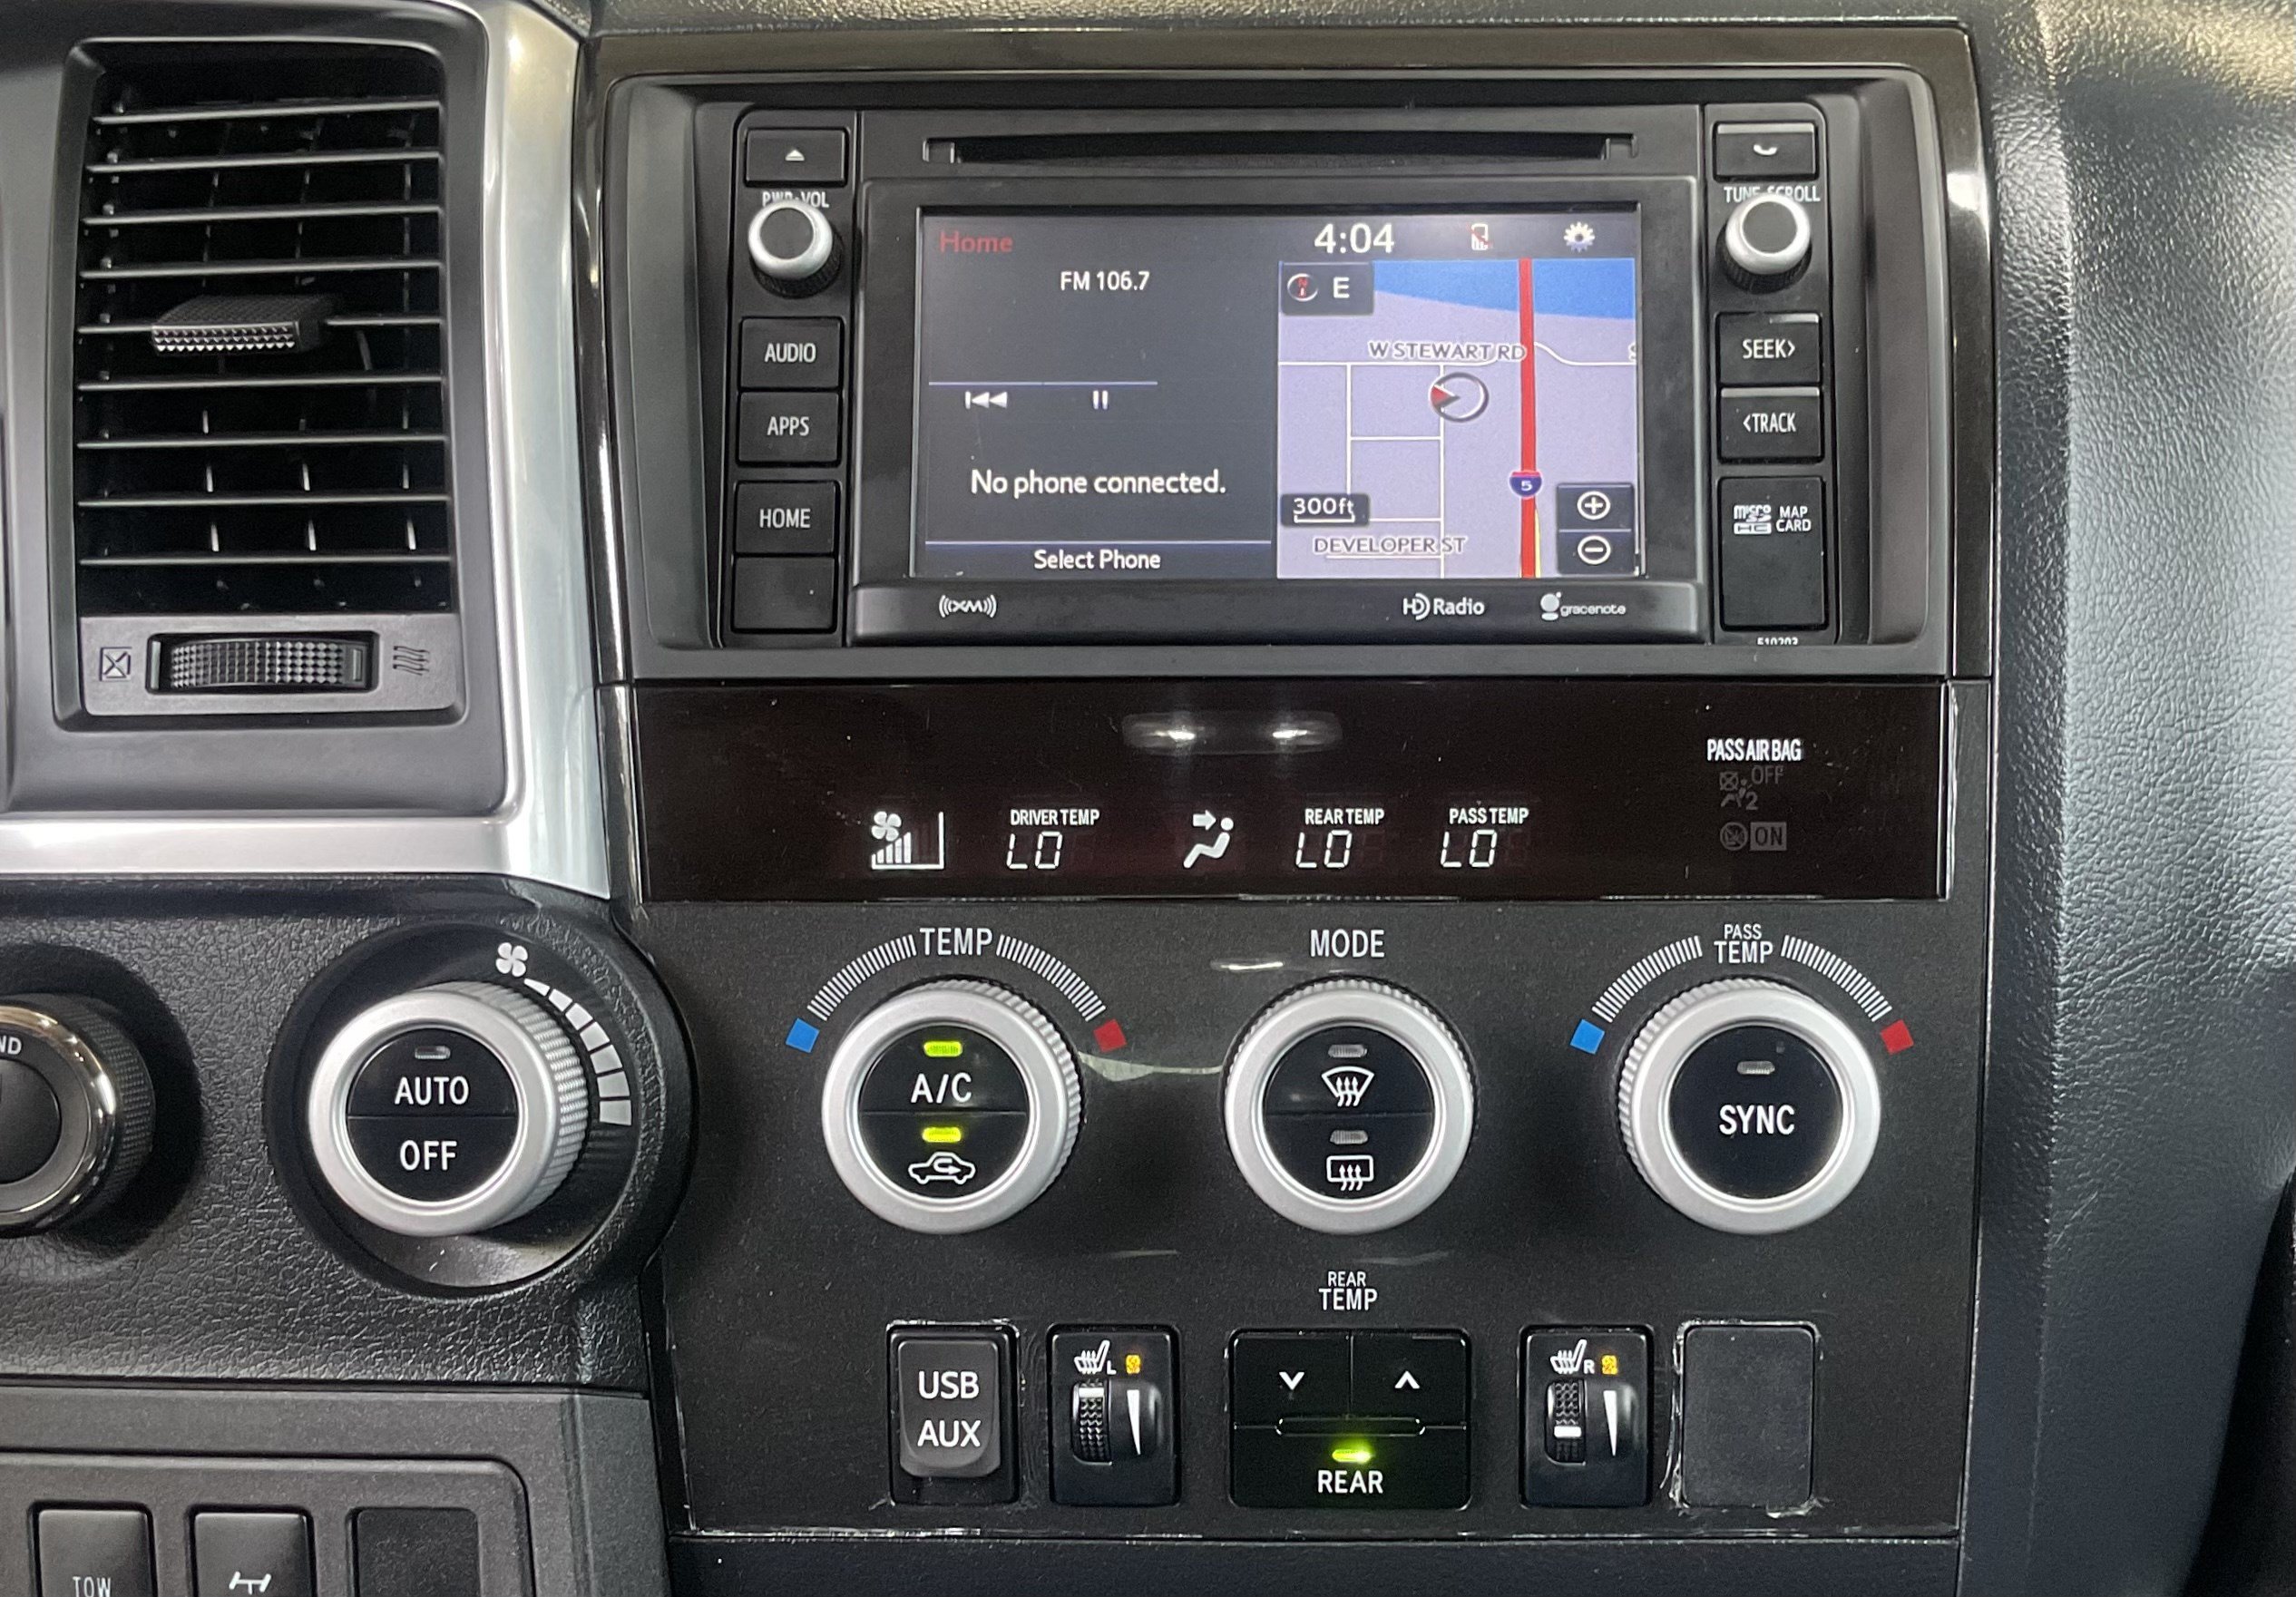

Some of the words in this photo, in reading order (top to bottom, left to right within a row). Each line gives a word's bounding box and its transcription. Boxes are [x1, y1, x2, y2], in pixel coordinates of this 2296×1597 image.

[940, 232, 1011, 251] Home
[1314, 223, 1394, 253] 4:04
[1061, 271, 1089, 290] FM
[1097, 271, 1149, 290] 106.7
[1334, 277, 1349, 297] E
[765, 343, 816, 362] AUDIO
[1368, 339, 1388, 359] W
[1393, 341, 1491, 360] STEWART
[1498, 345, 1526, 360] RD
[767, 417, 809, 435] APPS
[972, 469, 1007, 493] No
[1014, 469, 1087, 499] phone
[1094, 469, 1226, 493] connected.
[1521, 481, 1532, 491] 5
[1294, 498, 1353, 514] 300ft
[1780, 506, 1807, 519] MAP
[760, 509, 810, 528] HOME
[1776, 519, 1811, 531] CARD
[1314, 536, 1434, 555] DEVELOPER
[1441, 538, 1465, 553] ST
[1034, 550, 1094, 569] Select
[1100, 550, 1160, 569] Phone
[1434, 598, 1484, 615] Radio
[1560, 605, 1626, 617] gracenote
[1707, 738, 1744, 761] PASS
[1745, 738, 1770, 761] AIR
[1772, 738, 1802, 761] BAG
[1752, 765, 1784, 784] OFF
[1011, 810, 1058, 825] DRIVER
[1060, 809, 1099, 825] TEMP
[1305, 809, 1343, 824] REAR
[1346, 809, 1384, 824] TEMP
[1450, 808, 1487, 823] PASS
[1490, 808, 1529, 823] TEMP
[1754, 826, 1783, 846] ON
[920, 928, 992, 955] TEMP
[1724, 924, 1762, 940] PASS
[1311, 930, 1384, 957] MODE
[1714, 941, 1773, 963] TEMP
[395, 1076, 468, 1105] AUTO
[912, 1073, 972, 1103] A/C
[1720, 1105, 1794, 1134] SYNC
[400, 1140, 456, 1170] OFF
[1328, 1271, 1365, 1286] REAR
[1319, 1289, 1377, 1310] TEMP
[1107, 1360, 1116, 1375] L
[1584, 1359, 1595, 1374] R
[919, 1371, 979, 1398] USB
[918, 1420, 981, 1446] AUX
[1318, 1470, 1382, 1493] REAR
[73, 1576, 110, 1597] TOW
